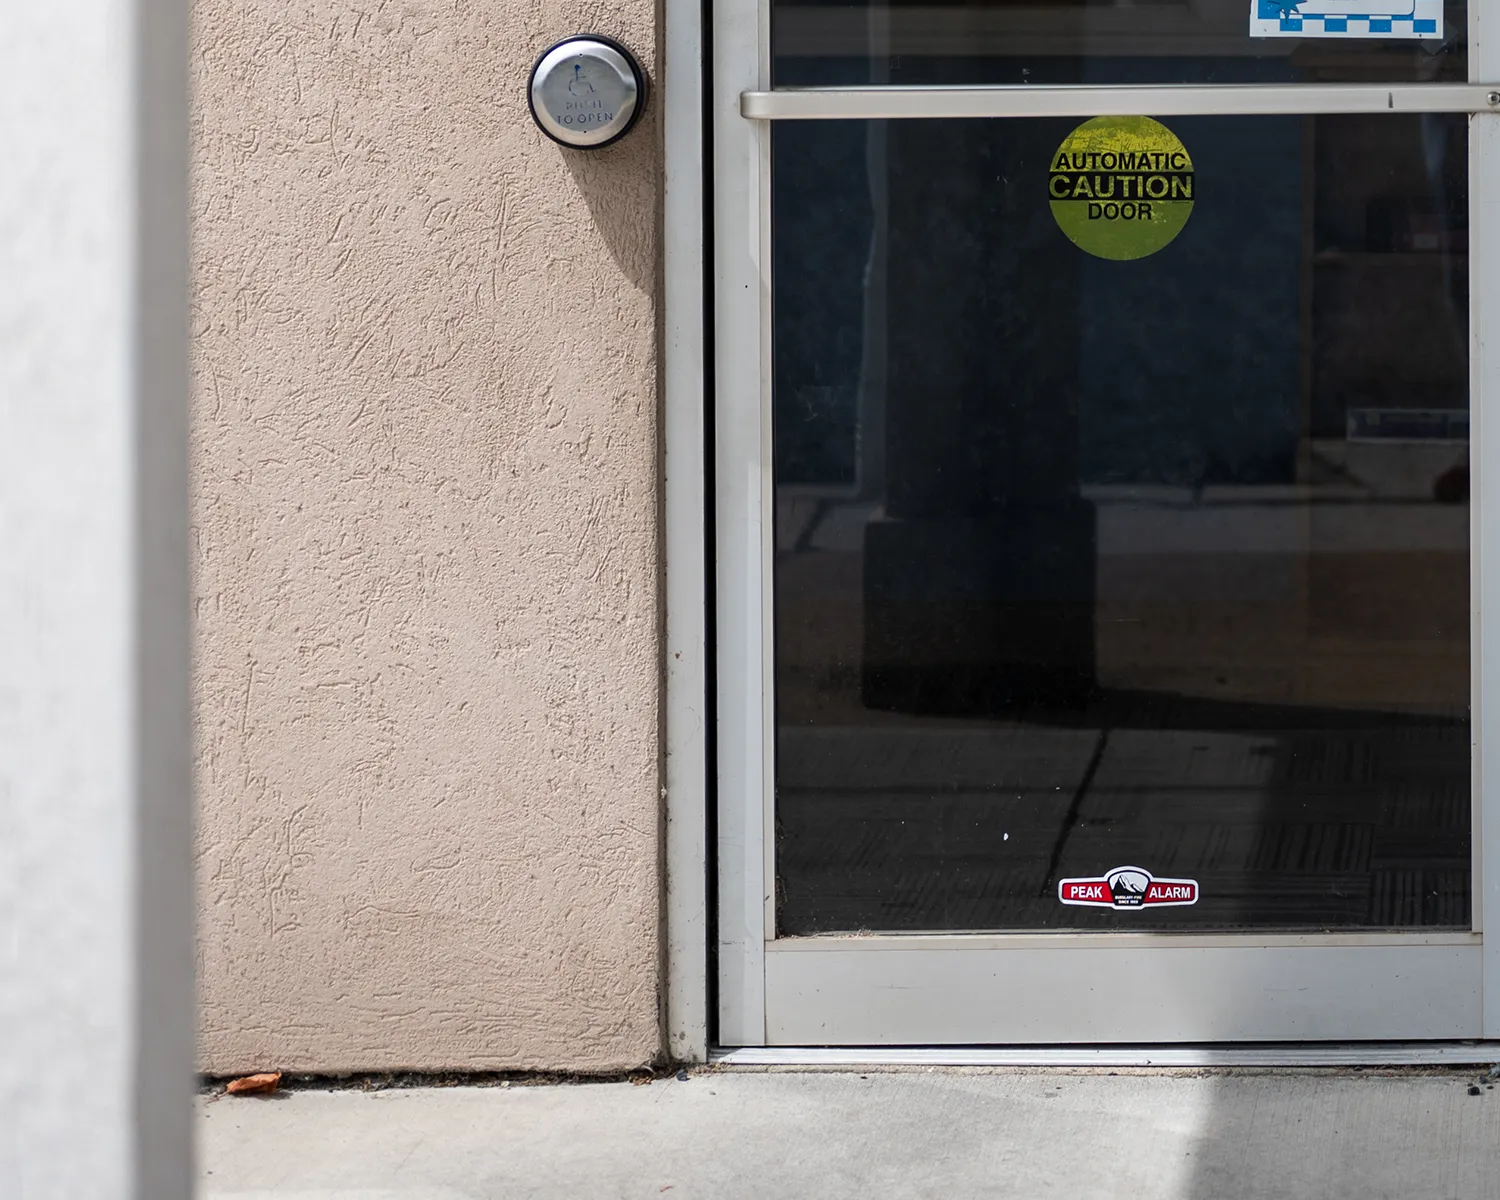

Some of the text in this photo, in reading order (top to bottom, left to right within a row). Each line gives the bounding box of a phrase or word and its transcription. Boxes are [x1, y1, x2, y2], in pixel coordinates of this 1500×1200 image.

[577, 113, 613, 123] OPEN
[1055, 152, 1185, 171] AUTOMATIC
[1049, 175, 1192, 199] CAUTION
[1088, 203, 1153, 221] DOOR
[1070, 886, 1191, 898] PEAK ALARM
